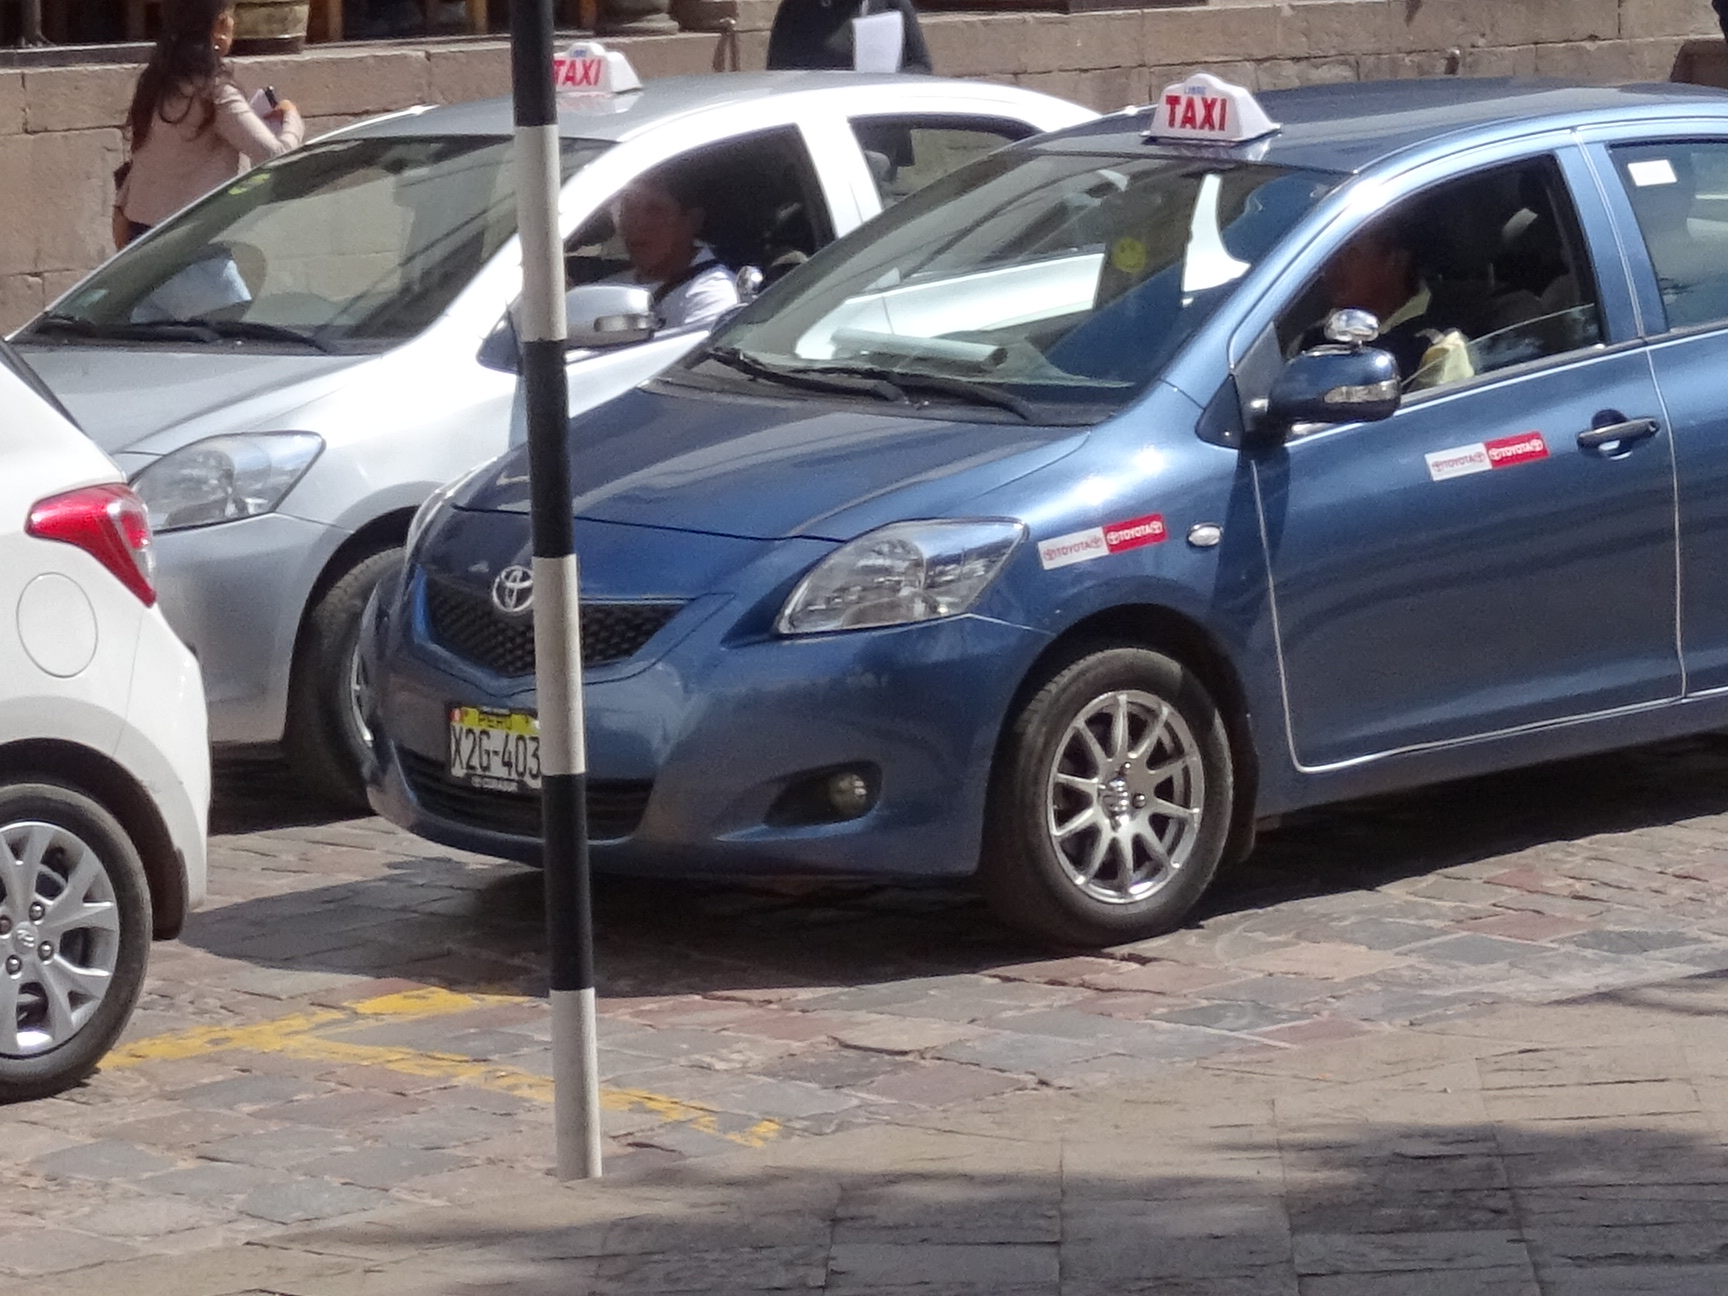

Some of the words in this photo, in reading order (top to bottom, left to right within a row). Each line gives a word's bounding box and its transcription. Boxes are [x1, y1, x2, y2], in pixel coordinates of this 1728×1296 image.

[553, 59, 602, 86] TAXI
[1165, 94, 1228, 131] TAXI
[1443, 453, 1474, 468] TOYOTA
[1500, 442, 1532, 458] TOYOTA
[1055, 541, 1091, 556] TOYOTA
[1119, 525, 1152, 541] TOYOTA
[451, 722, 541, 780] X2G-403
